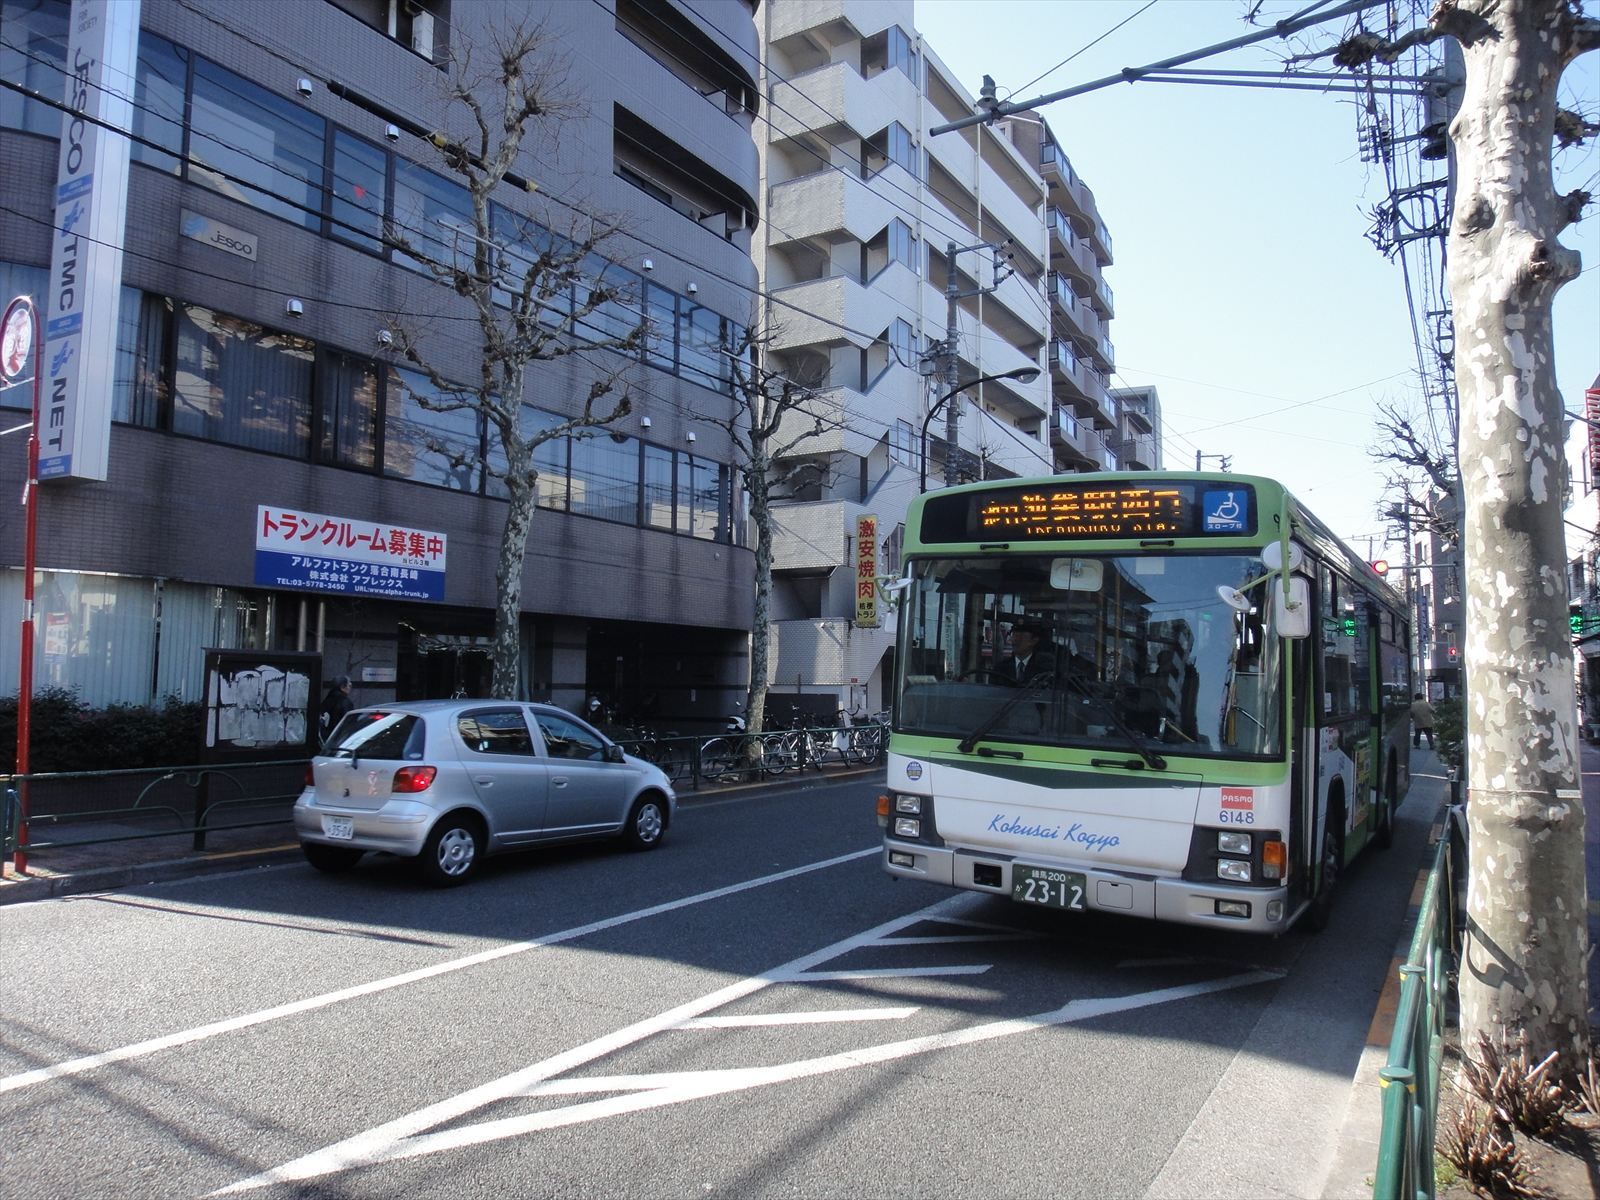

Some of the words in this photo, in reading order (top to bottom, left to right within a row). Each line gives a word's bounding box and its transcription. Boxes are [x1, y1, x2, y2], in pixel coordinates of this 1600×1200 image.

[60, 236, 78, 311] TMC
[49, 377, 67, 451] NET
[263, 510, 443, 561] トランクルーム募集中
[291, 556, 369, 573] アルファトランク
[309, 570, 349, 583] 株式会社
[858, 520, 875, 599] 激安焼肉
[1222, 795, 1253, 803] PASMO
[988, 814, 1058, 839] Kokusai
[1063, 823, 1120, 852] Kogyo
[1219, 810, 1254, 824] 6148
[1024, 878, 1083, 910] 23-12
